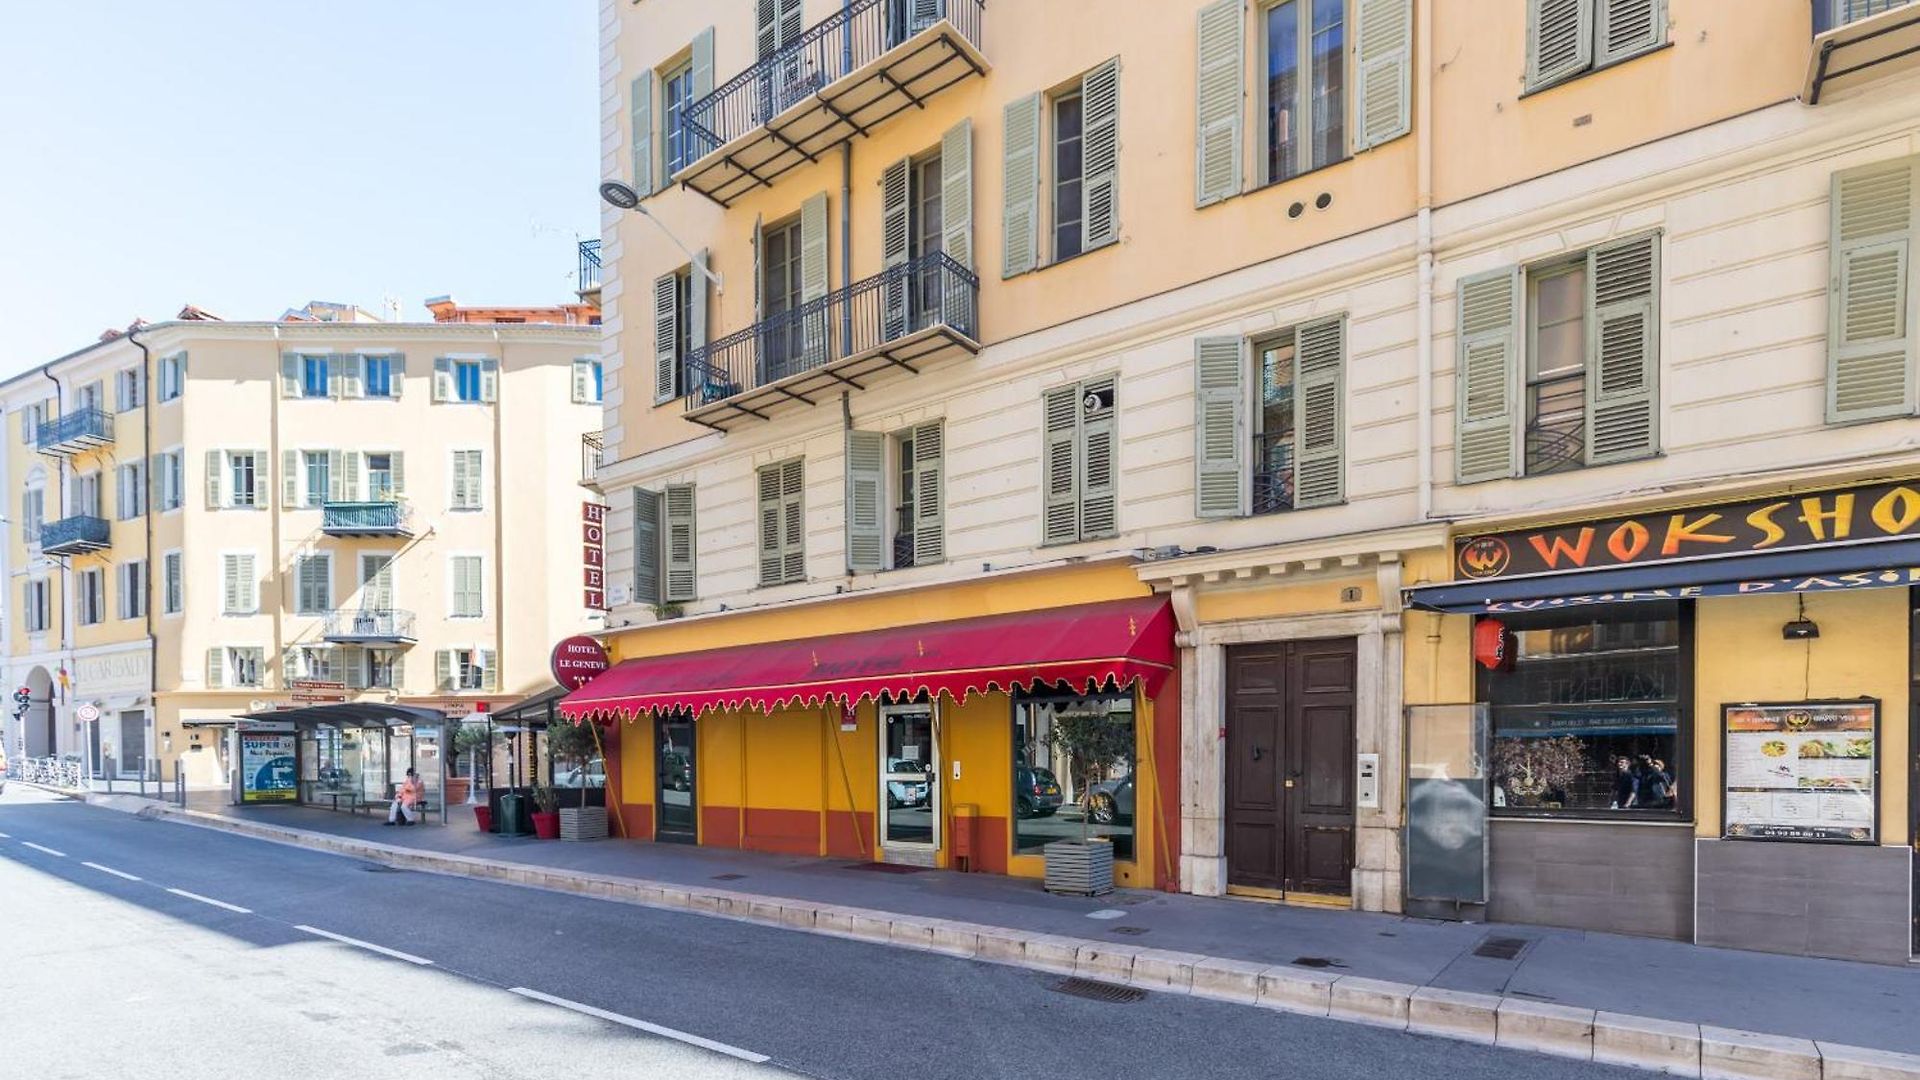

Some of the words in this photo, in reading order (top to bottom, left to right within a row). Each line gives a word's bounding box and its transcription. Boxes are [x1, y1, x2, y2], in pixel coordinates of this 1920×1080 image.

[587, 504, 601, 608] HOTEL
[568, 644, 598, 654] HOTEL
[559, 659, 572, 668] LE
